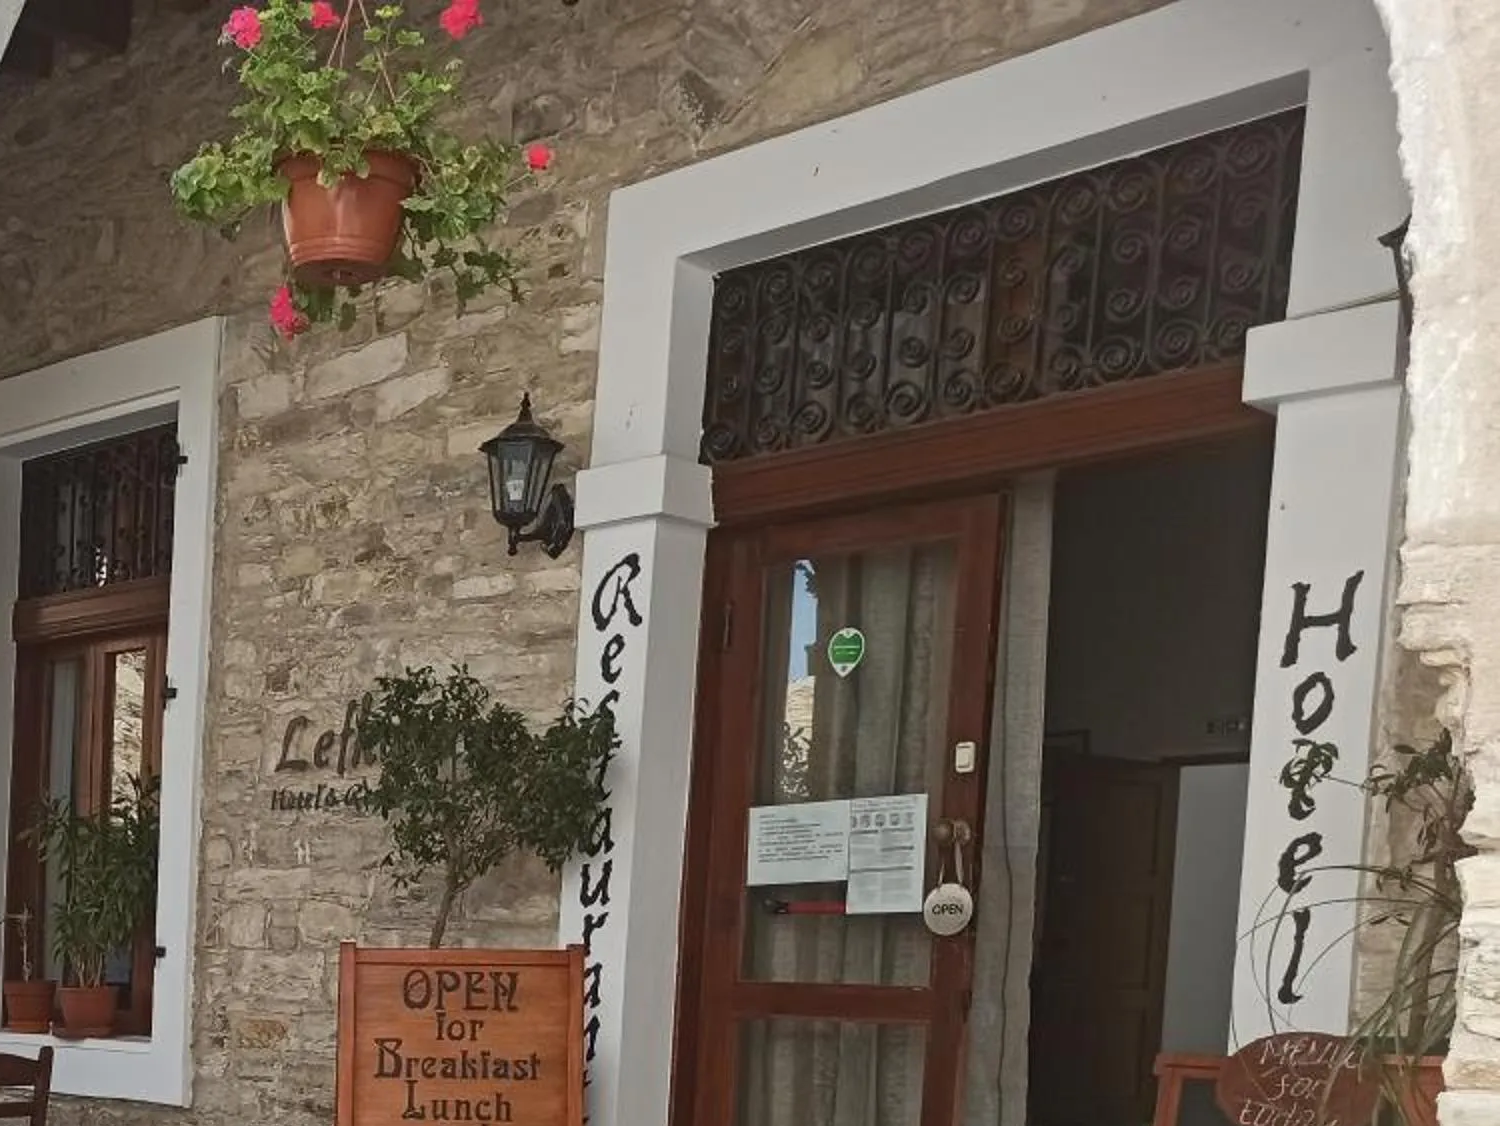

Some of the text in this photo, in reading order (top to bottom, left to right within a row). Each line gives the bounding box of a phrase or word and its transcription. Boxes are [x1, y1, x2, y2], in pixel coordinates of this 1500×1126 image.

[1278, 570, 1364, 1004] Hotel
[931, 903, 965, 916] OPEN
[403, 969, 518, 1012] OPEN
[435, 1011, 484, 1041] for
[373, 1037, 541, 1080] Breakfast
[402, 1079, 513, 1122] Lunch
